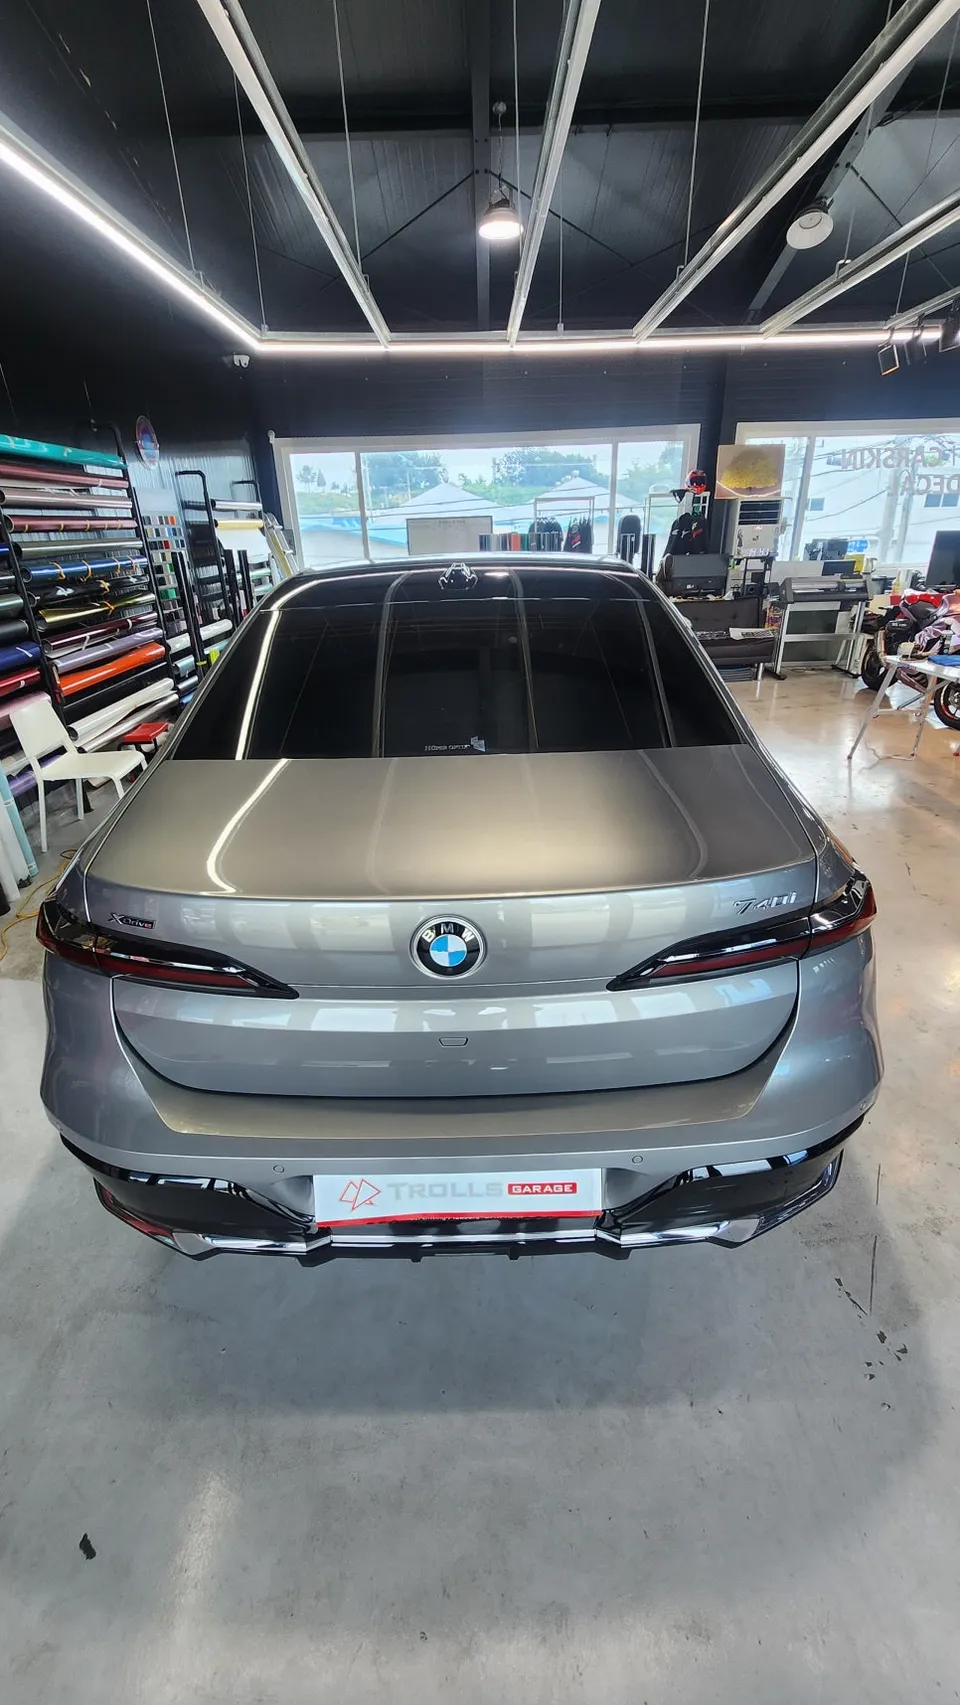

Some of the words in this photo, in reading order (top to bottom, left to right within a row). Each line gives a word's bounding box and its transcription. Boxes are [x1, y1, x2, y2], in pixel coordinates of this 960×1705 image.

[733, 891, 797, 915] 740i
[421, 922, 475, 943] BMW
[386, 1180, 503, 1200] TROLLS
[511, 1182, 574, 1194] GARAGE
